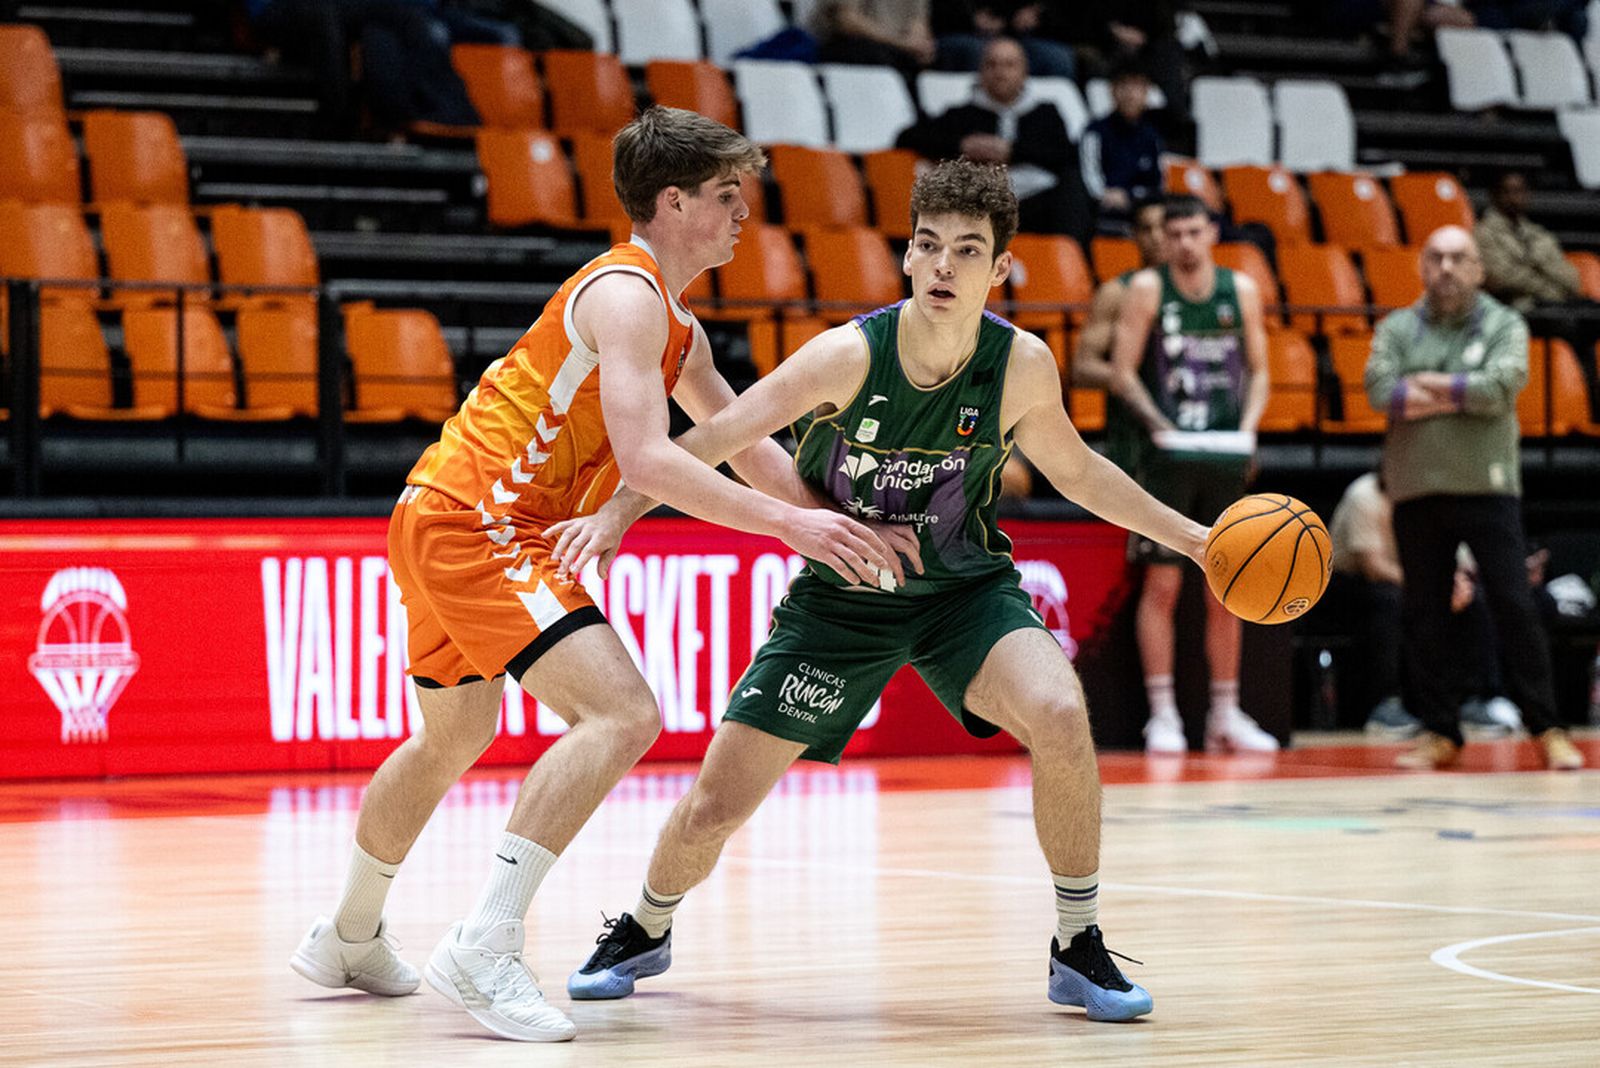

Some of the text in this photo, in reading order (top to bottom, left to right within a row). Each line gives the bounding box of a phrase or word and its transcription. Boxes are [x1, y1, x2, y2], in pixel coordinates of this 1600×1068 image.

[960, 406, 979, 417] LIGA
[798, 662, 847, 689] CLINICAS
[777, 702, 818, 724] DENTAL
